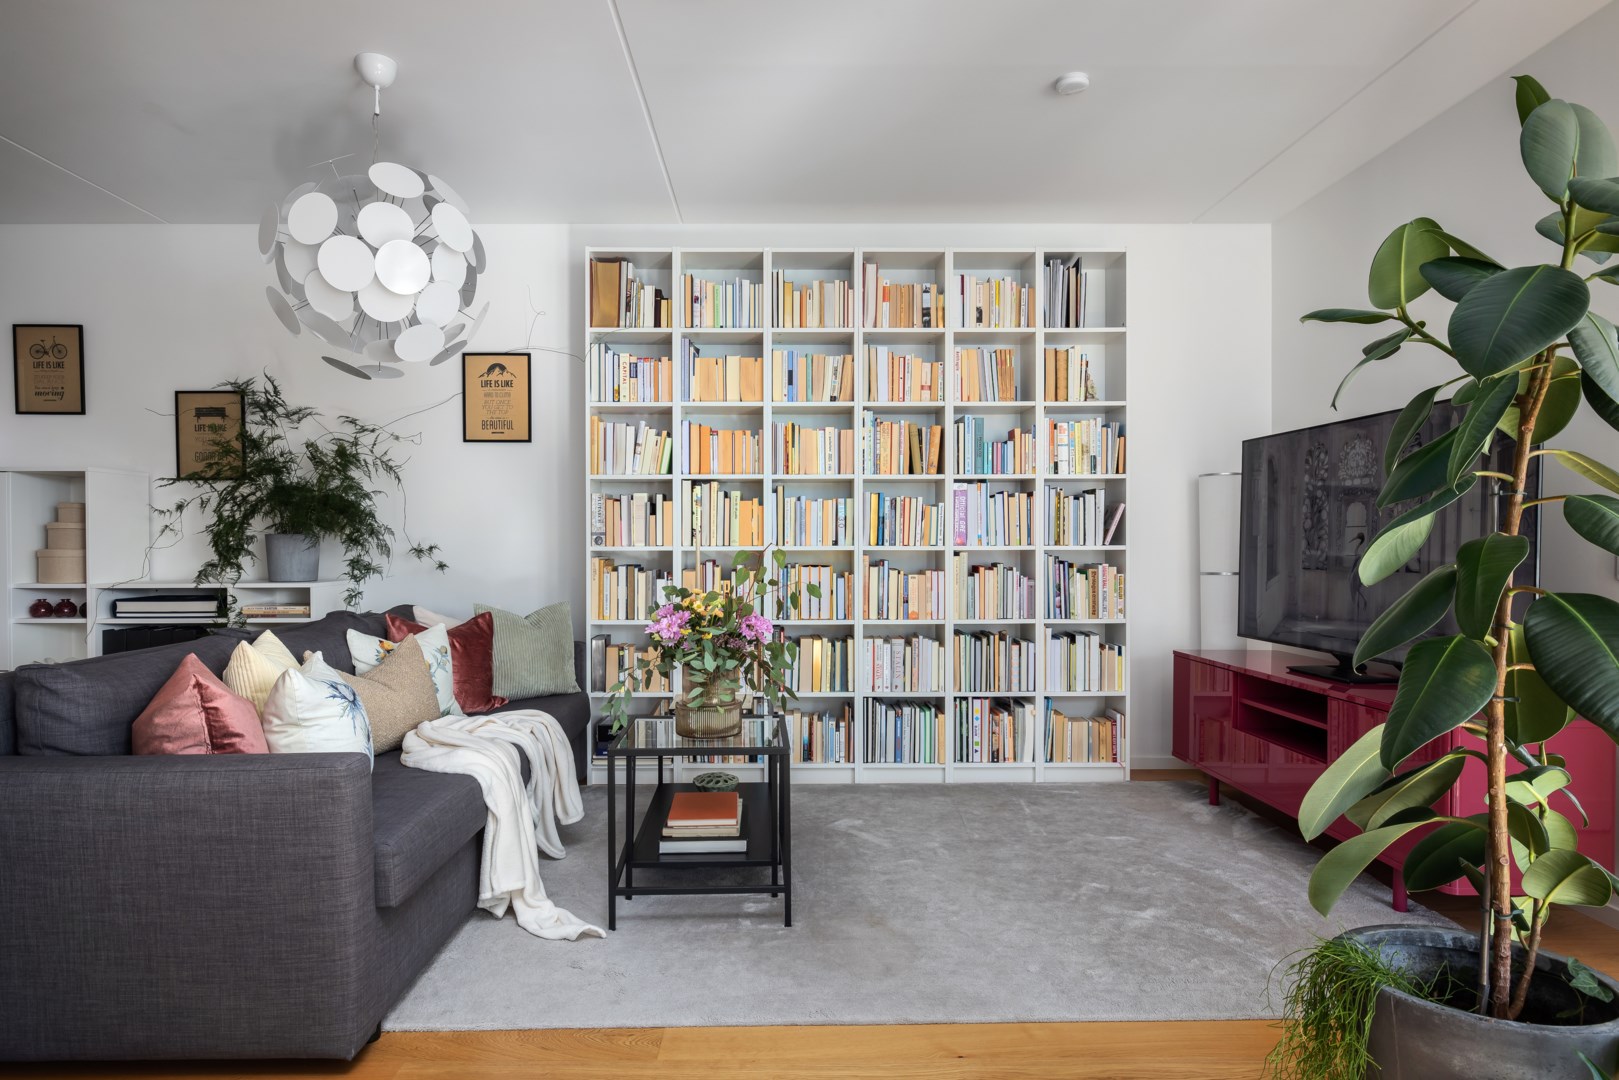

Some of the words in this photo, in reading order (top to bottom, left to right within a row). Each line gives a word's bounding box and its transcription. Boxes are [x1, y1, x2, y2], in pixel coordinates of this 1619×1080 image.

[481, 380, 492, 388] LIFE
[494, 380, 500, 388] IS
[501, 380, 514, 388] LIKE
[195, 424, 206, 432] LIFE
[482, 420, 514, 430] BEAUTIFUL
